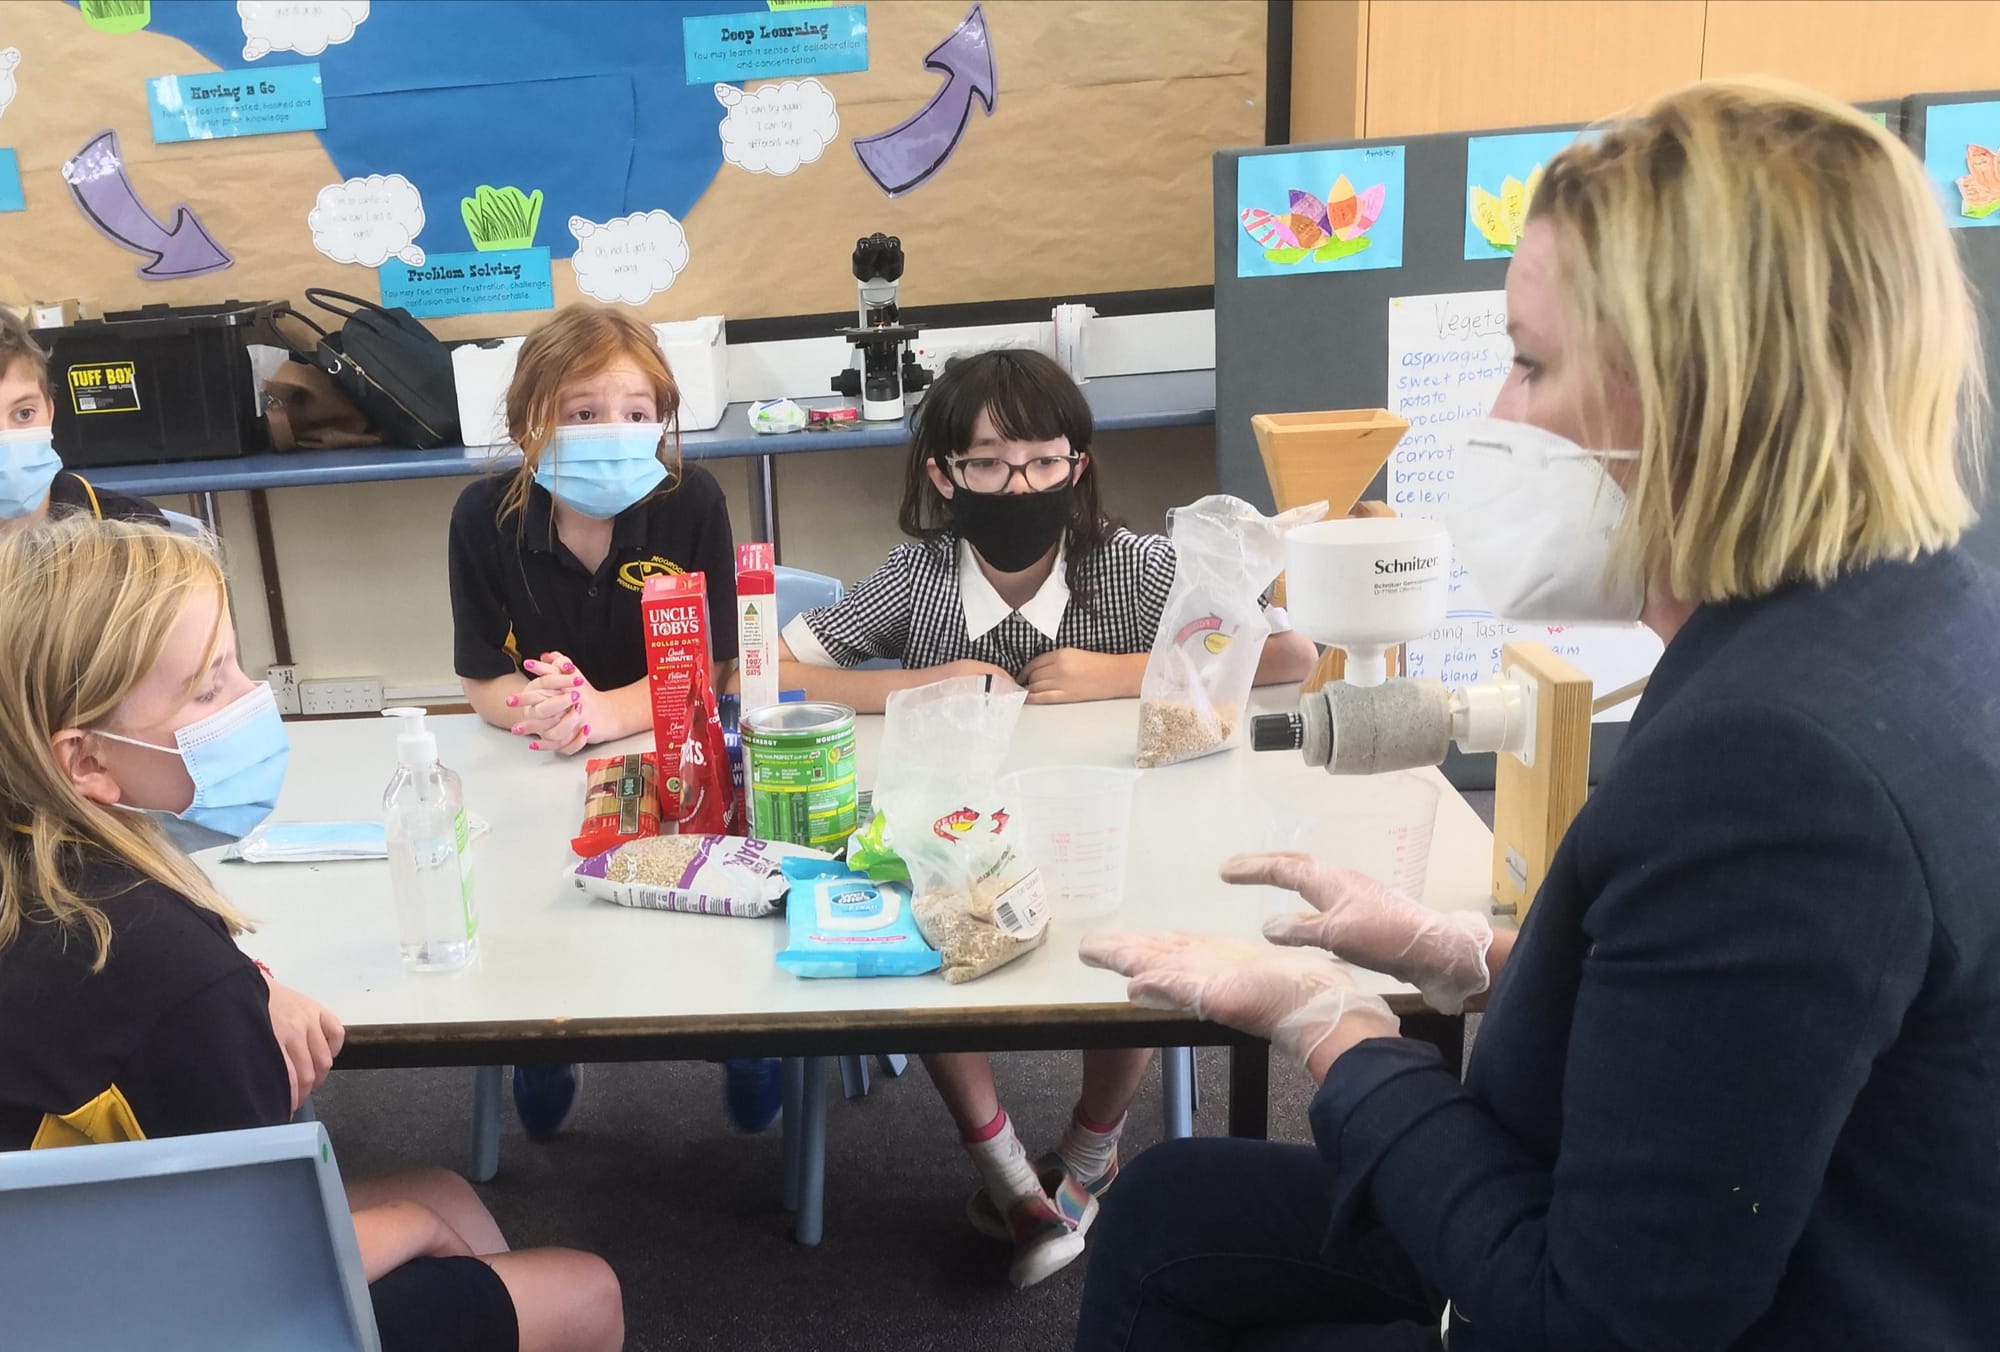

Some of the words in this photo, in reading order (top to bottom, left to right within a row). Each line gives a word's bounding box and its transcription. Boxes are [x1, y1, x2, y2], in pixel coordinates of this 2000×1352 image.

[190, 84, 241, 102] Having
[246, 86, 255, 95] a
[259, 82, 275, 94] Go
[408, 266, 465, 282] Problem
[469, 263, 521, 280] Solving
[70, 369, 101, 387] TUFF
[105, 367, 131, 385] BOX
[1397, 373, 1451, 390] sweet
[1400, 391, 1447, 413] potato
[1400, 402, 1482, 426] roccolini
[648, 605, 698, 623] UNCLE
[650, 620, 699, 637] TOBYS
[651, 640, 680, 648] ROLLED
[1444, 650, 1477, 665] plain
[1441, 669, 1479, 683] bland
